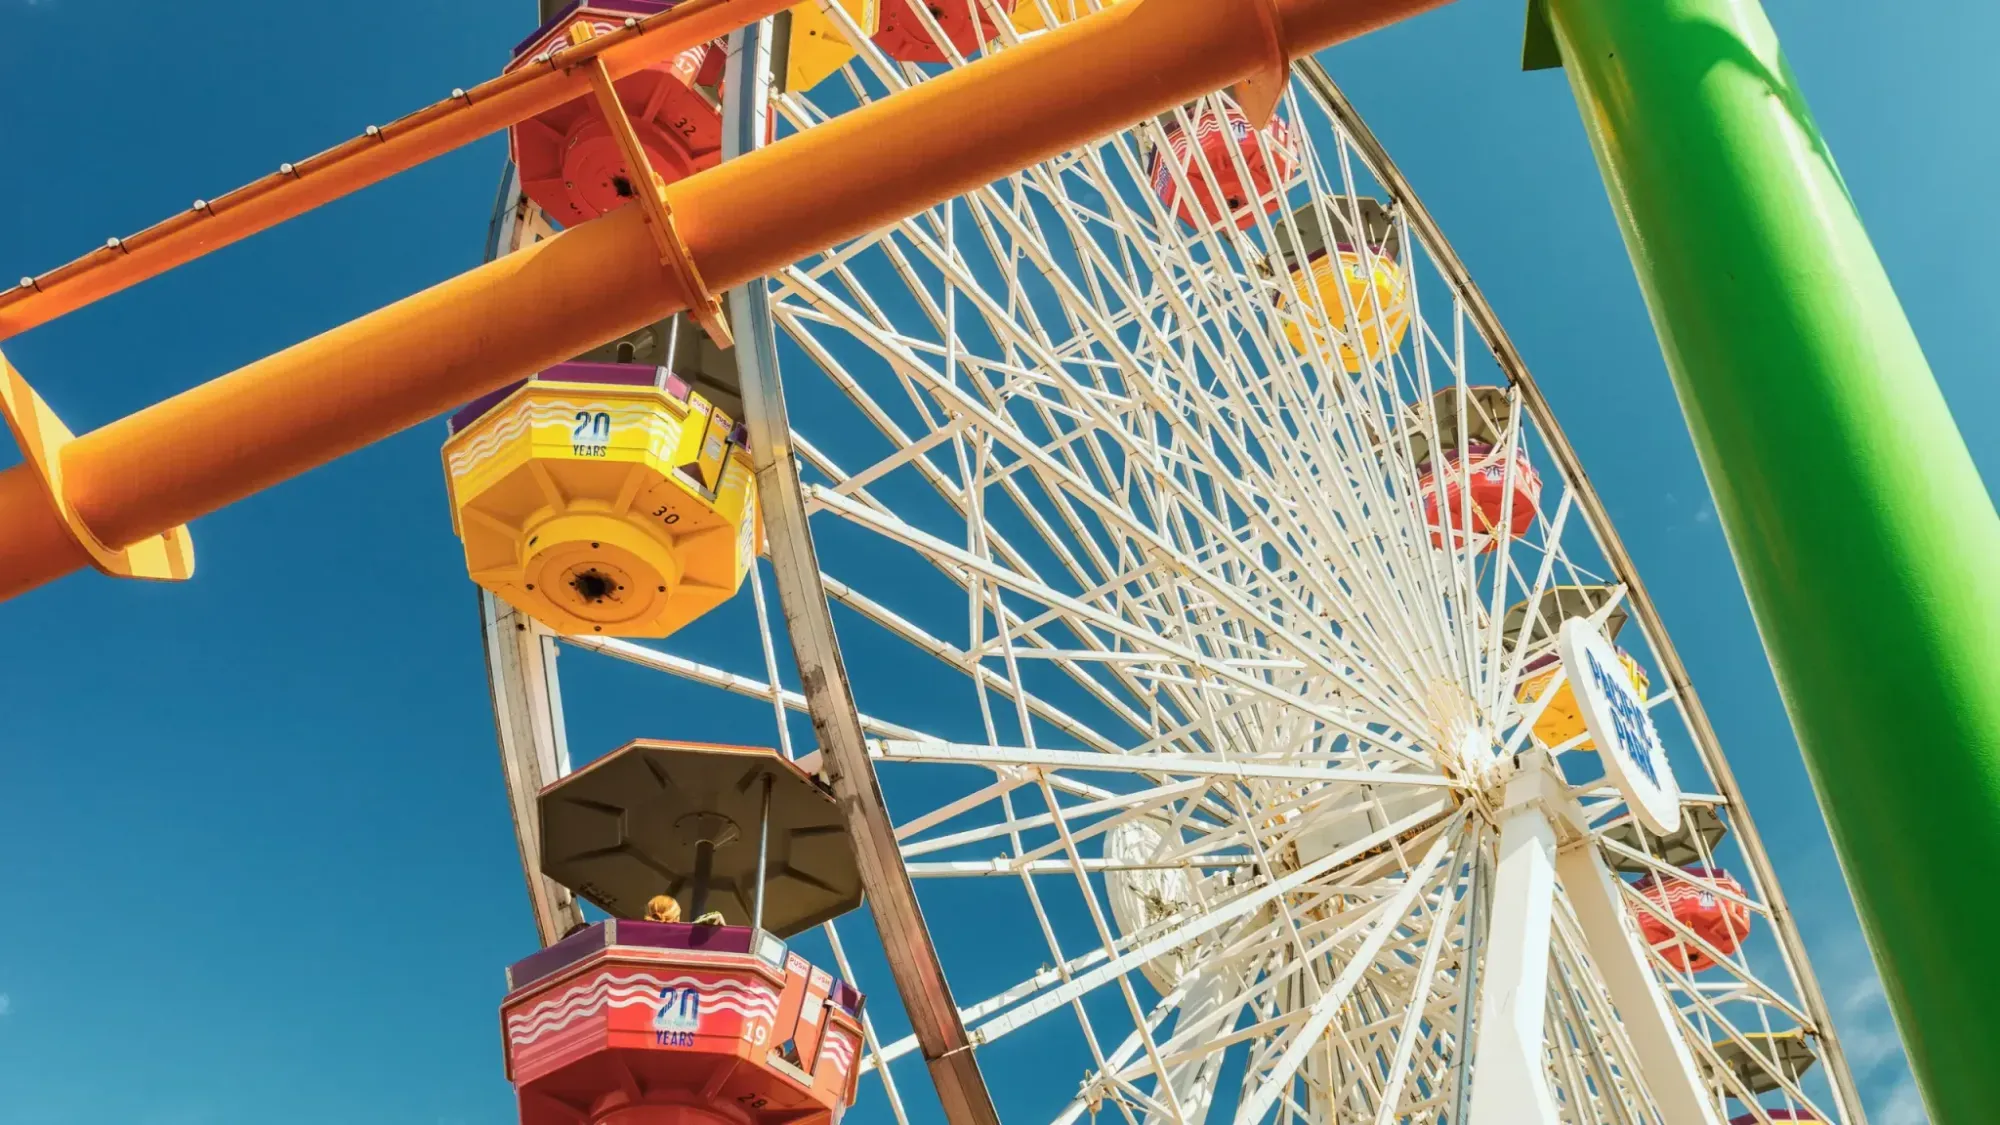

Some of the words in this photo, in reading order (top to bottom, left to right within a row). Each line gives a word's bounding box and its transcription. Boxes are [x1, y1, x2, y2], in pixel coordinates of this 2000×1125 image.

[674, 117, 697, 137] 32
[573, 411, 610, 440] 20
[573, 444, 607, 457] YEARS
[652, 505, 680, 525] 30
[1585, 646, 1653, 750] PACIFIC
[1609, 706, 1662, 792] PARK
[789, 956, 808, 971] PUSH
[656, 986, 699, 1025] 20
[656, 1030, 696, 1047] YEARS
[743, 1020, 767, 1047] 19
[737, 1092, 768, 1109] 28
